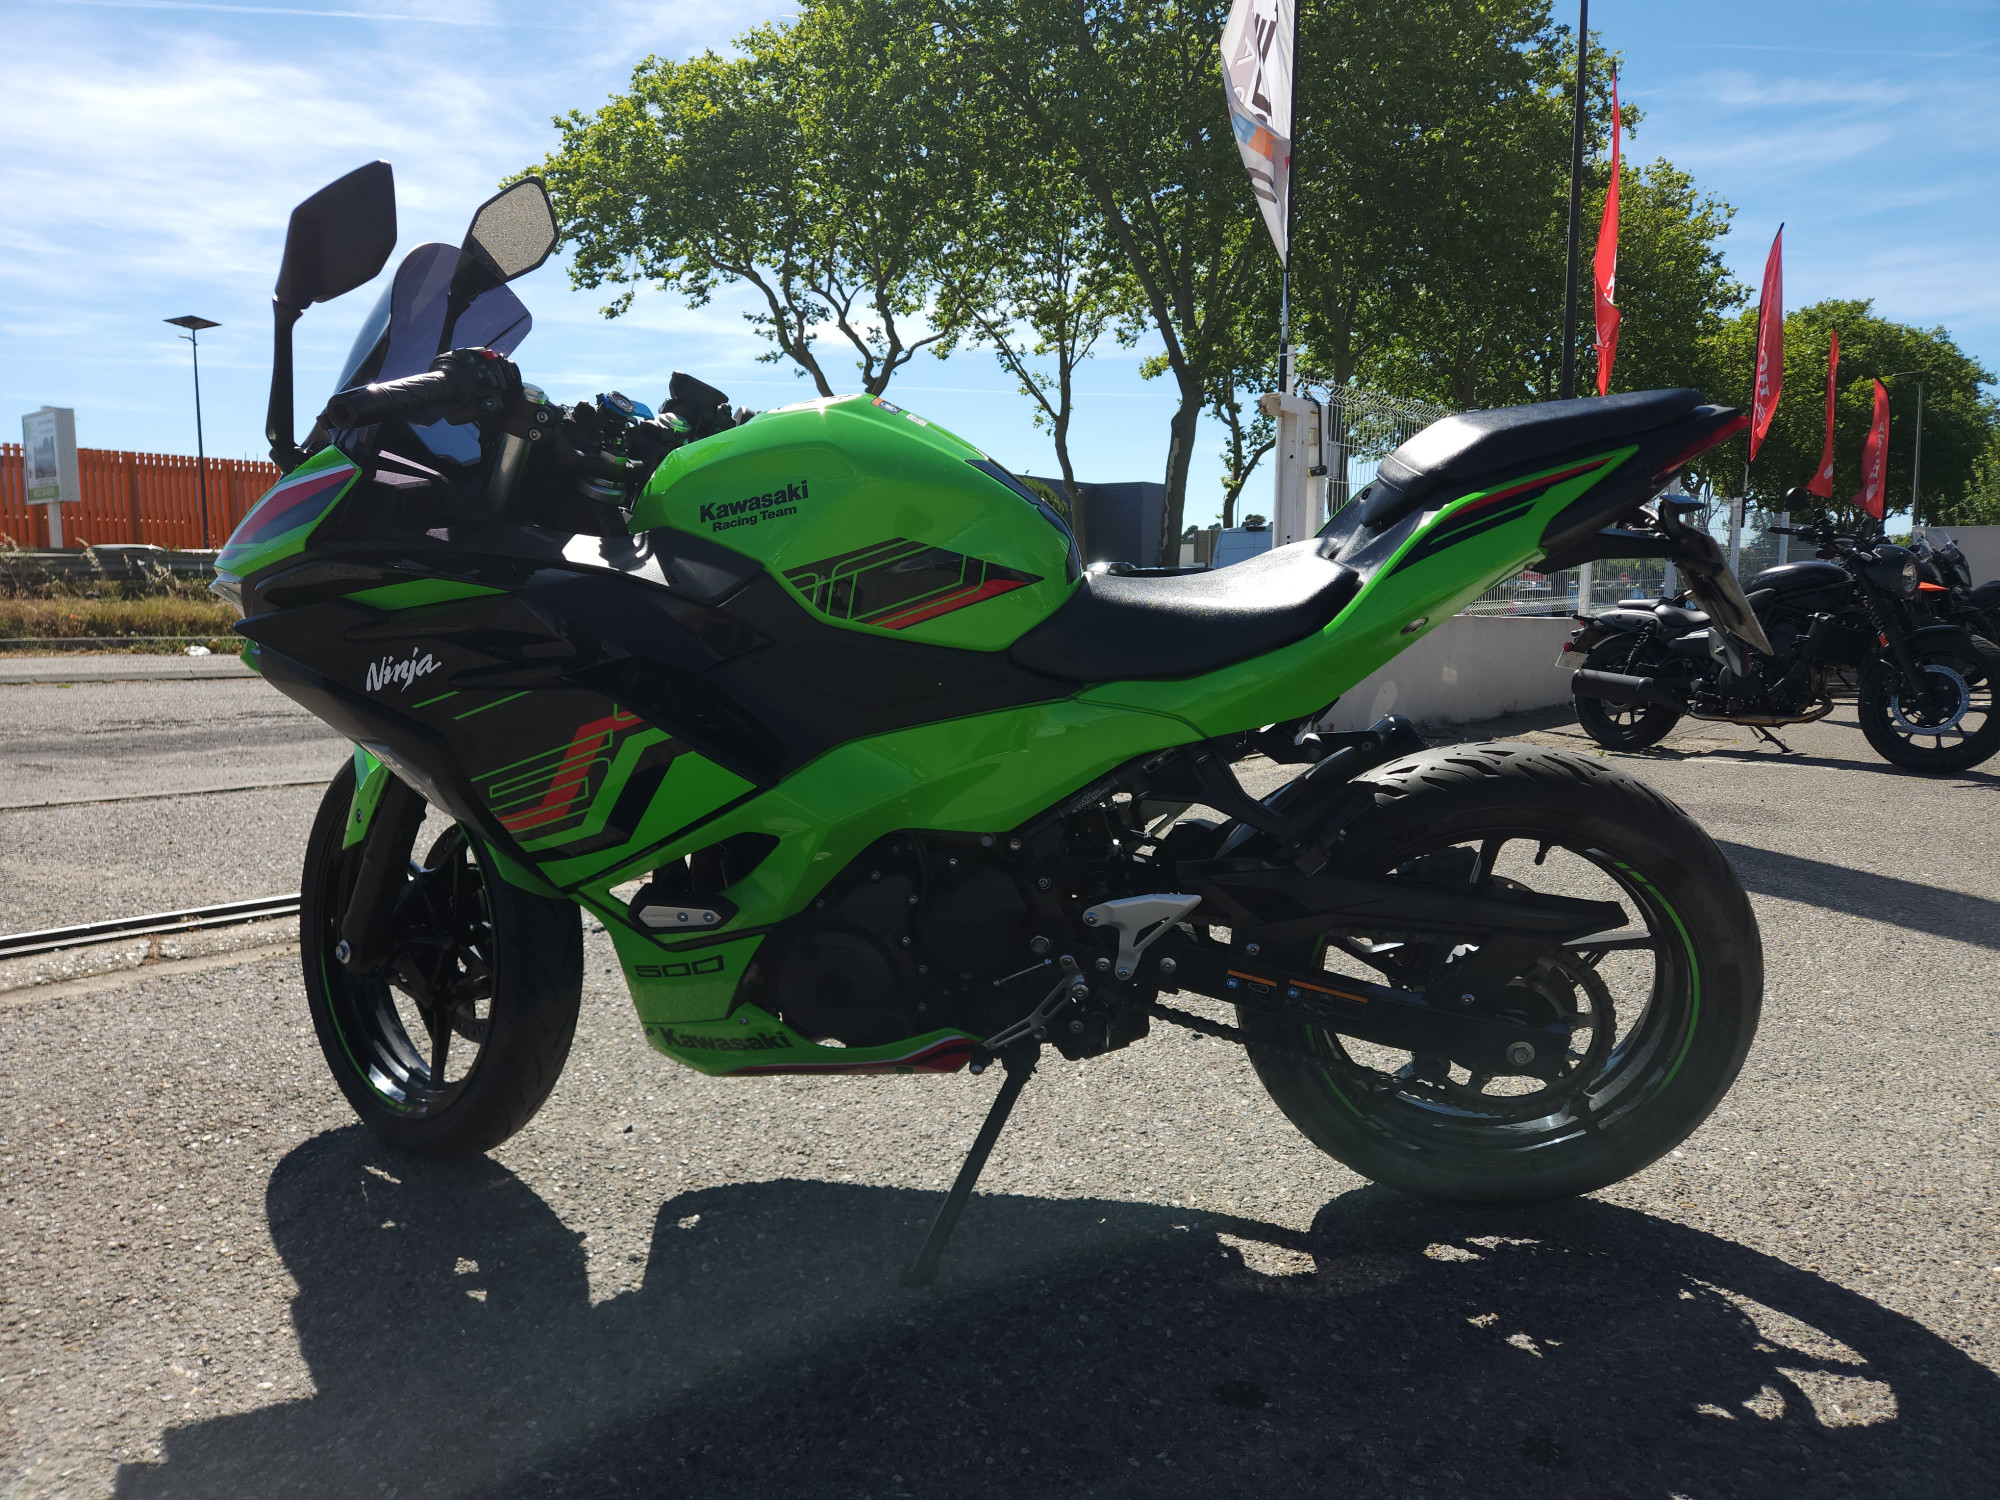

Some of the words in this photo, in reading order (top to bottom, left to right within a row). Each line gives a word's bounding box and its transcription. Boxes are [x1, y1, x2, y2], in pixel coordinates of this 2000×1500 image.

[700, 480, 808, 523] Kawasaki
[713, 515, 757, 532] Racing
[760, 506, 797, 520] Team
[366, 646, 442, 692] Ninja
[634, 955, 724, 977] 500
[658, 1025, 793, 1051] Kawasaki
